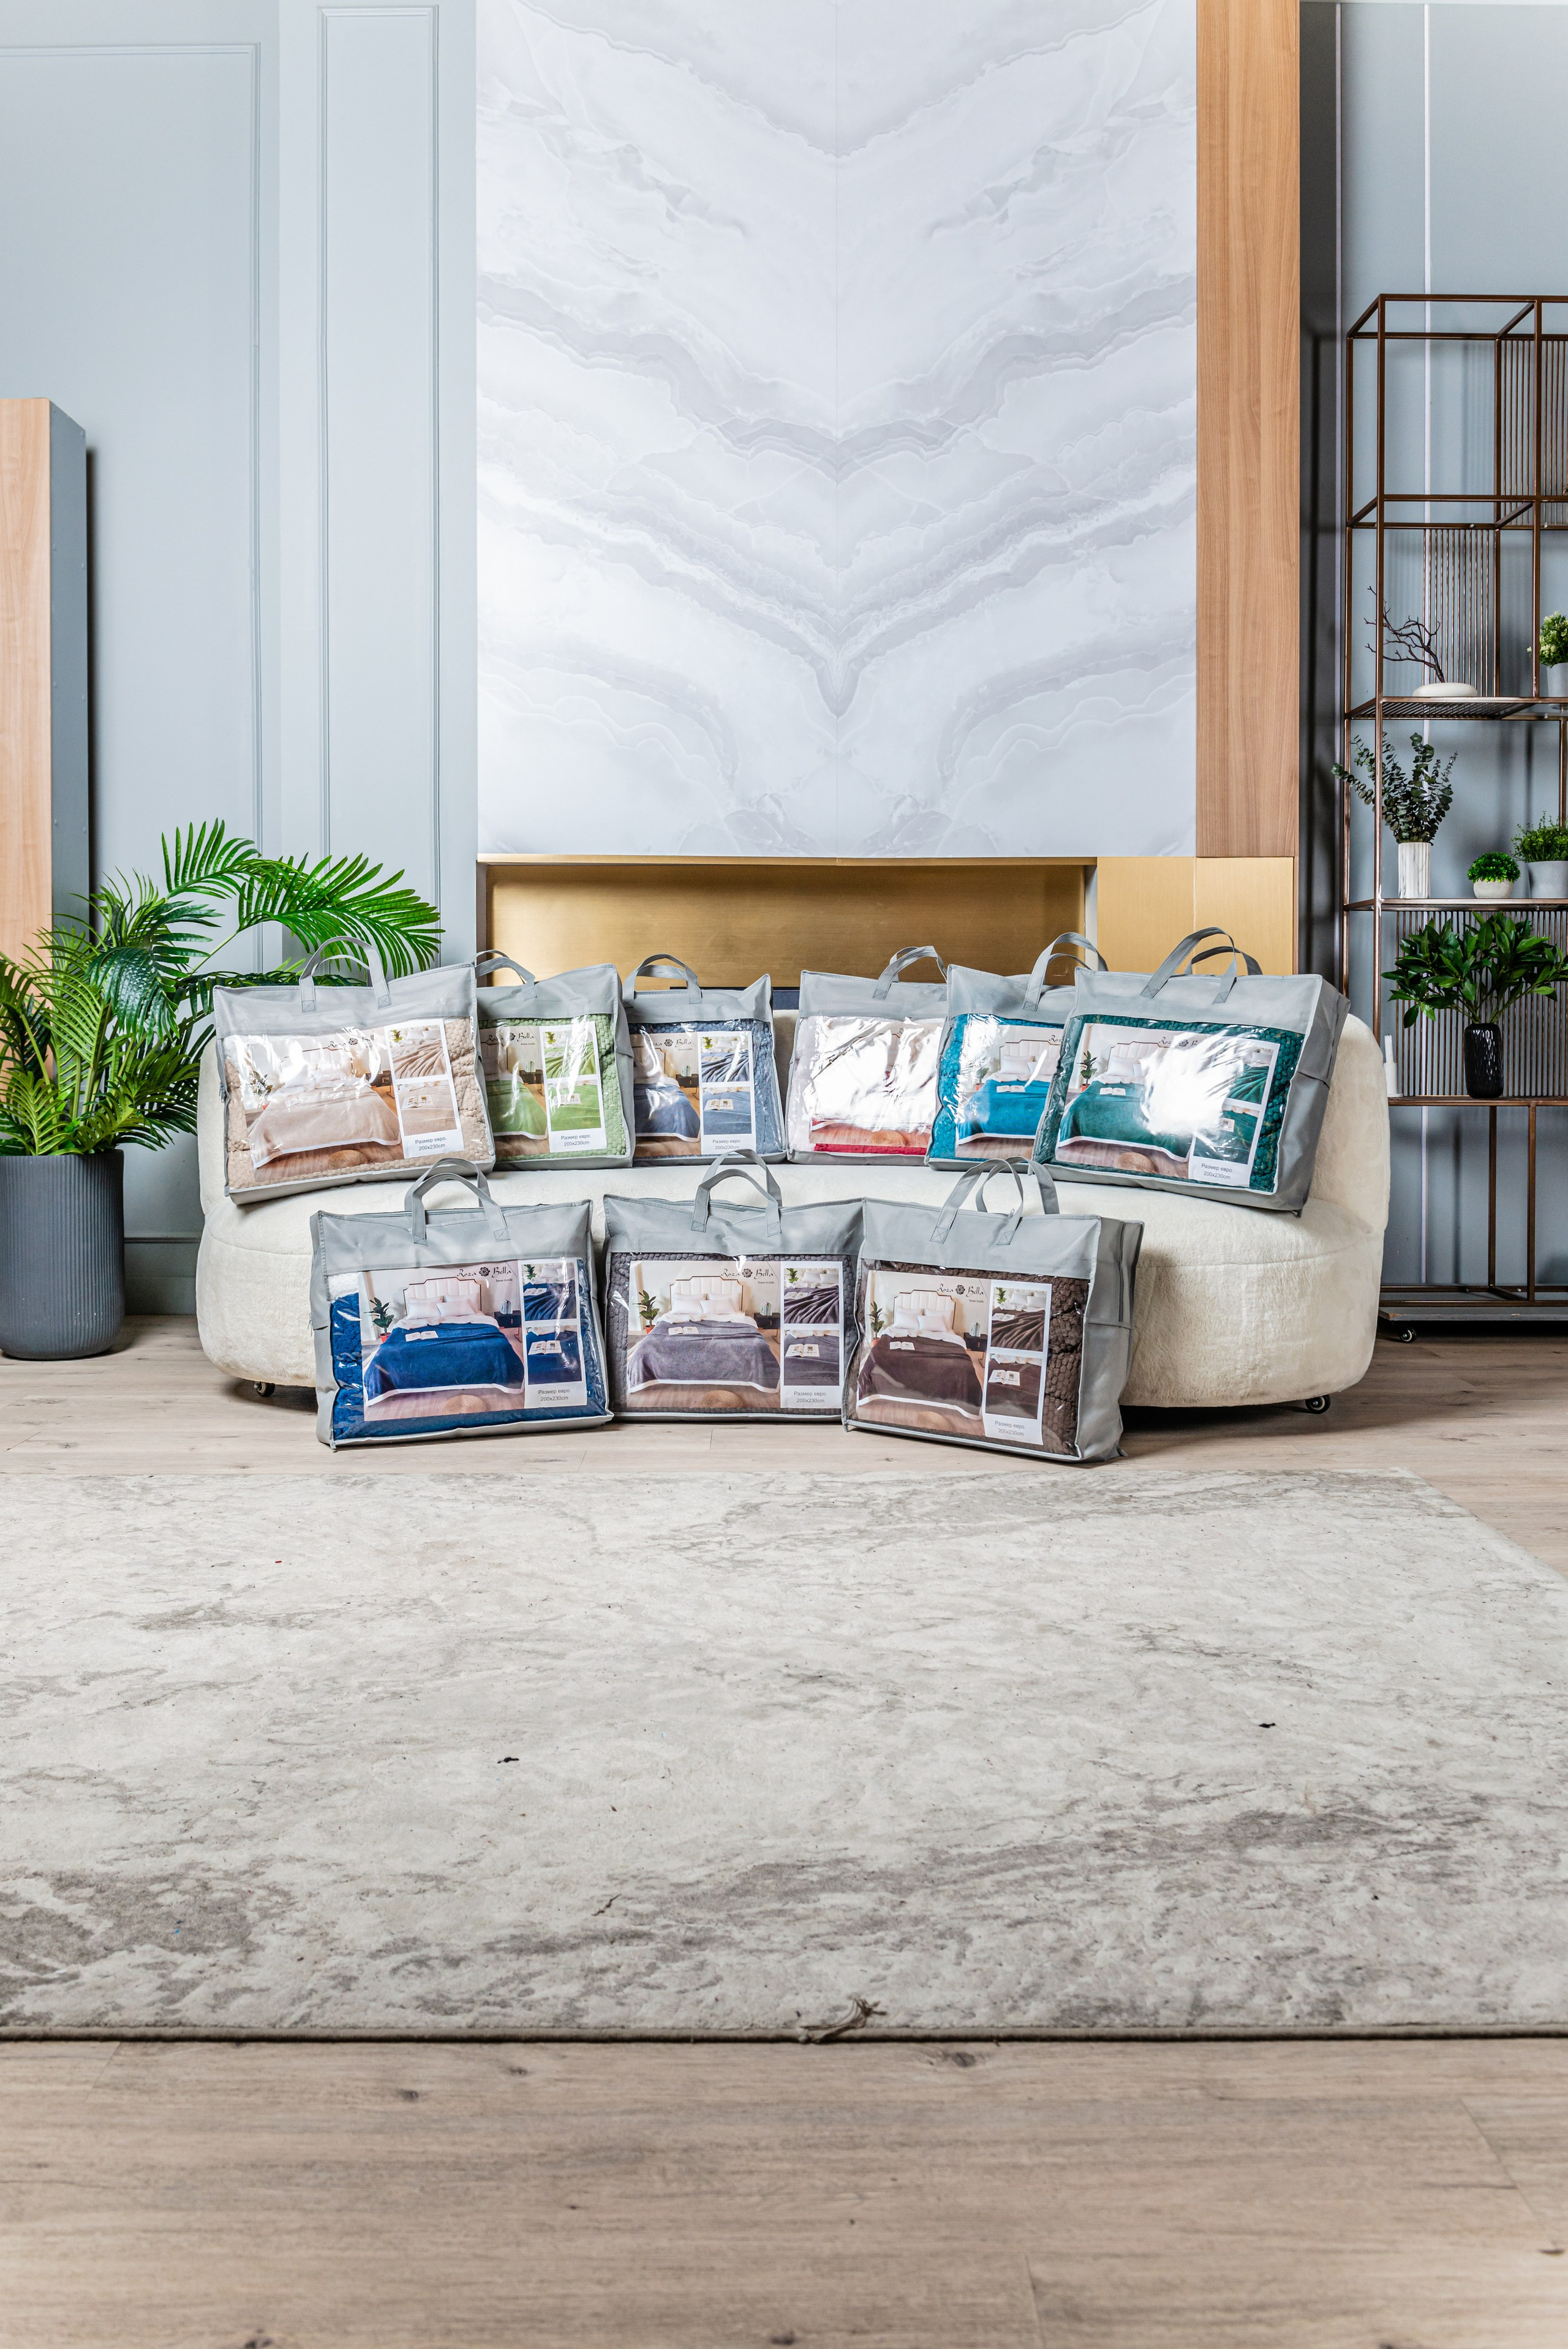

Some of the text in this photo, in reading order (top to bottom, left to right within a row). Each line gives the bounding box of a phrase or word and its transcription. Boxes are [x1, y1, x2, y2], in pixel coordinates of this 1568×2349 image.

[456, 1266, 511, 1278] Roza Bella
[721, 1268, 774, 1280] Roza Bella
[937, 1283, 984, 1297] Roza Bella
